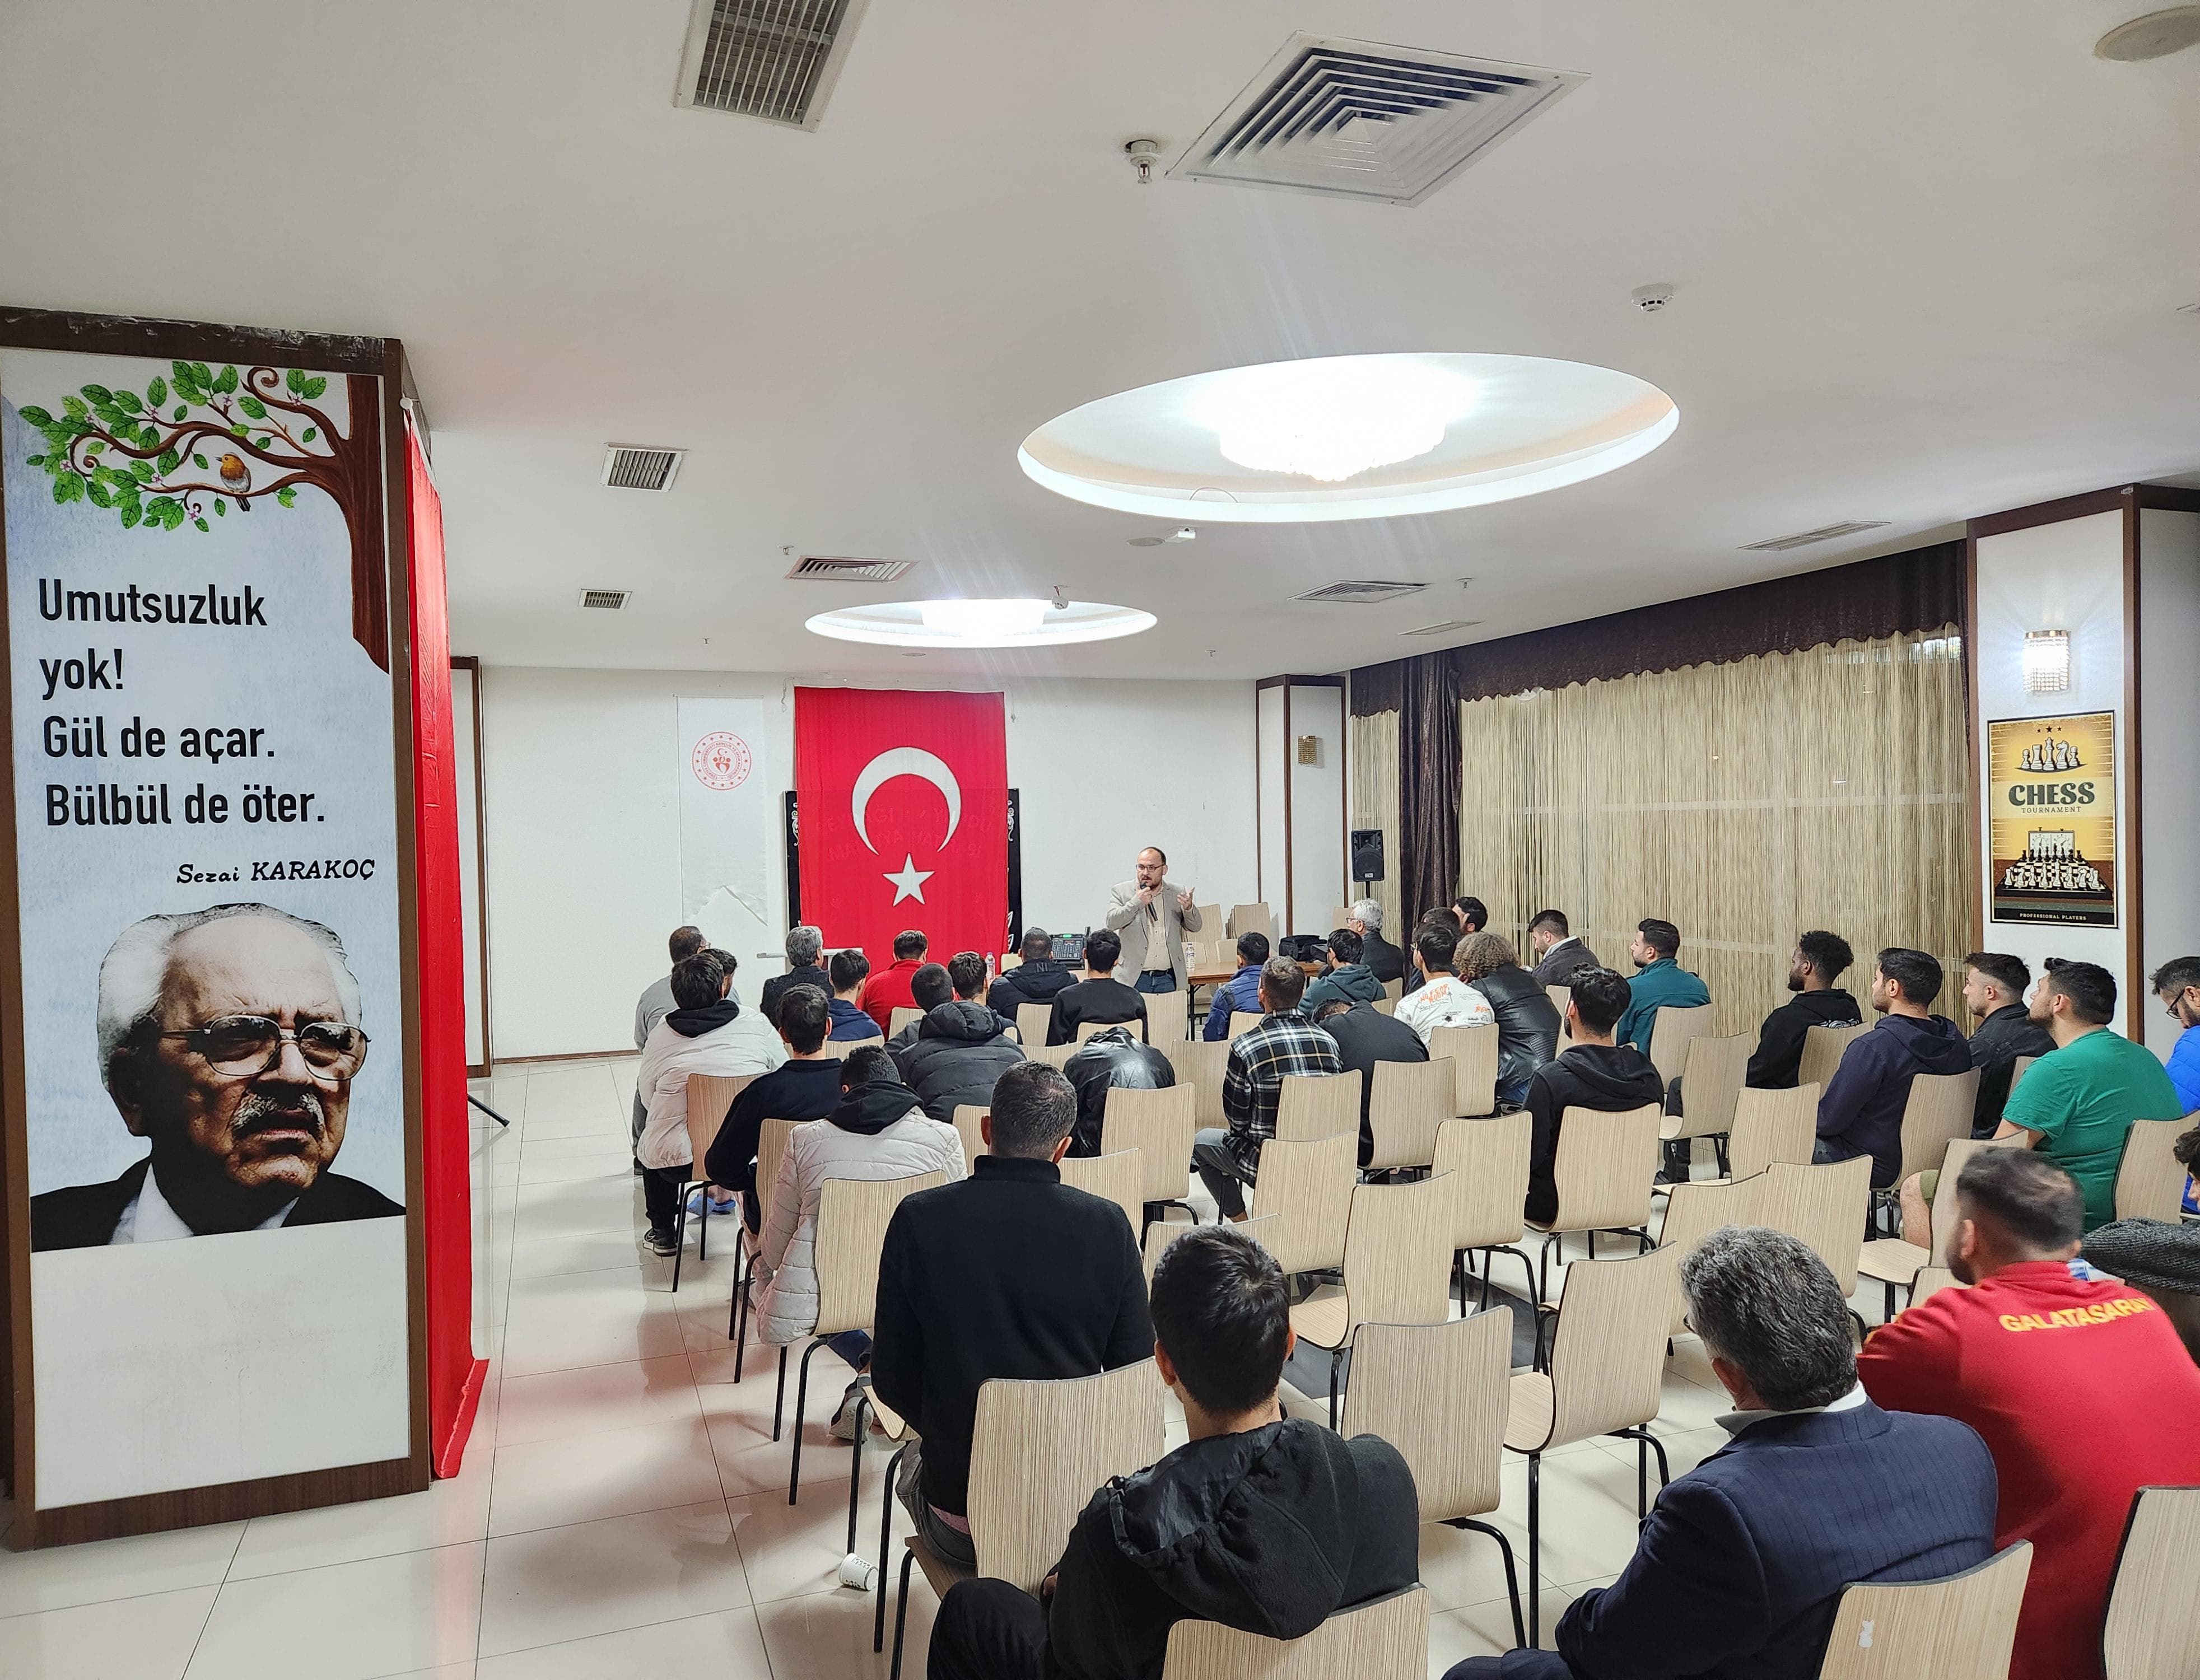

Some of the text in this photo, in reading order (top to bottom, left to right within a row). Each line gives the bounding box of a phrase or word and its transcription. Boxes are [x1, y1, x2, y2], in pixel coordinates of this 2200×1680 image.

[39, 578, 268, 626] Umutsuzluk
[39, 648, 123, 701] yok!
[43, 715, 274, 764] Gül de açar.
[46, 783, 325, 826] Bülbül de öter.
[2008, 782, 2095, 806] CHESS
[176, 858, 375, 884] Sezai KARAKOÇ
[1999, 1298, 2156, 1332] GALATASARAY
